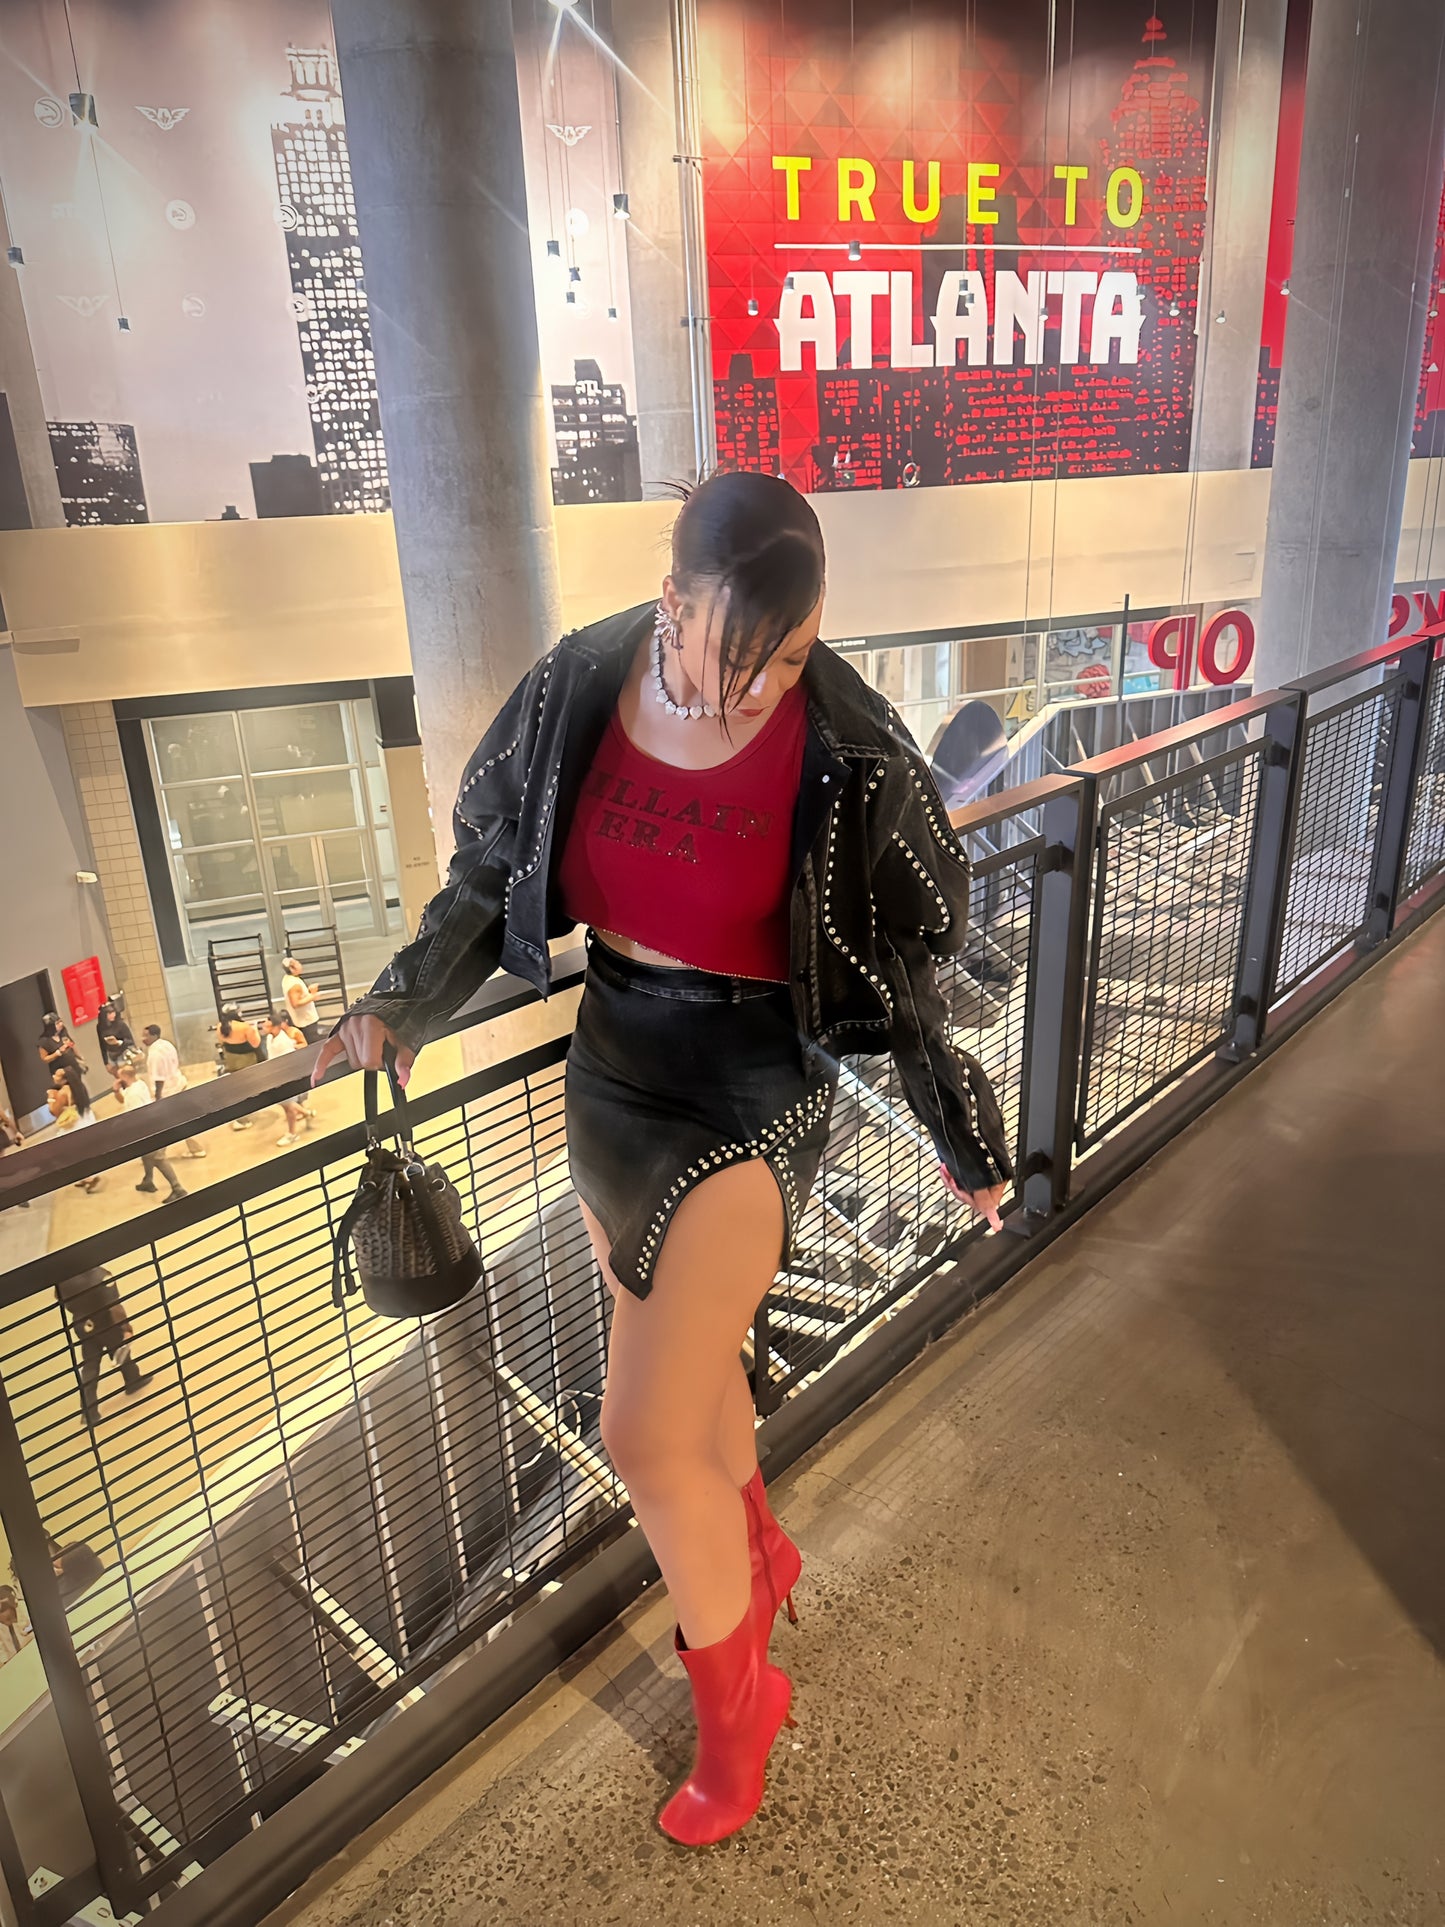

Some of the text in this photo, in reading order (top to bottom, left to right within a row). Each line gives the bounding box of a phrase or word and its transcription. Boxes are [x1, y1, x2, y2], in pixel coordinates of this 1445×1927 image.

[772, 155, 1144, 229] TRUE TO
[773, 270, 1147, 372] ATLANTA
[596, 809, 701, 865] ERA
